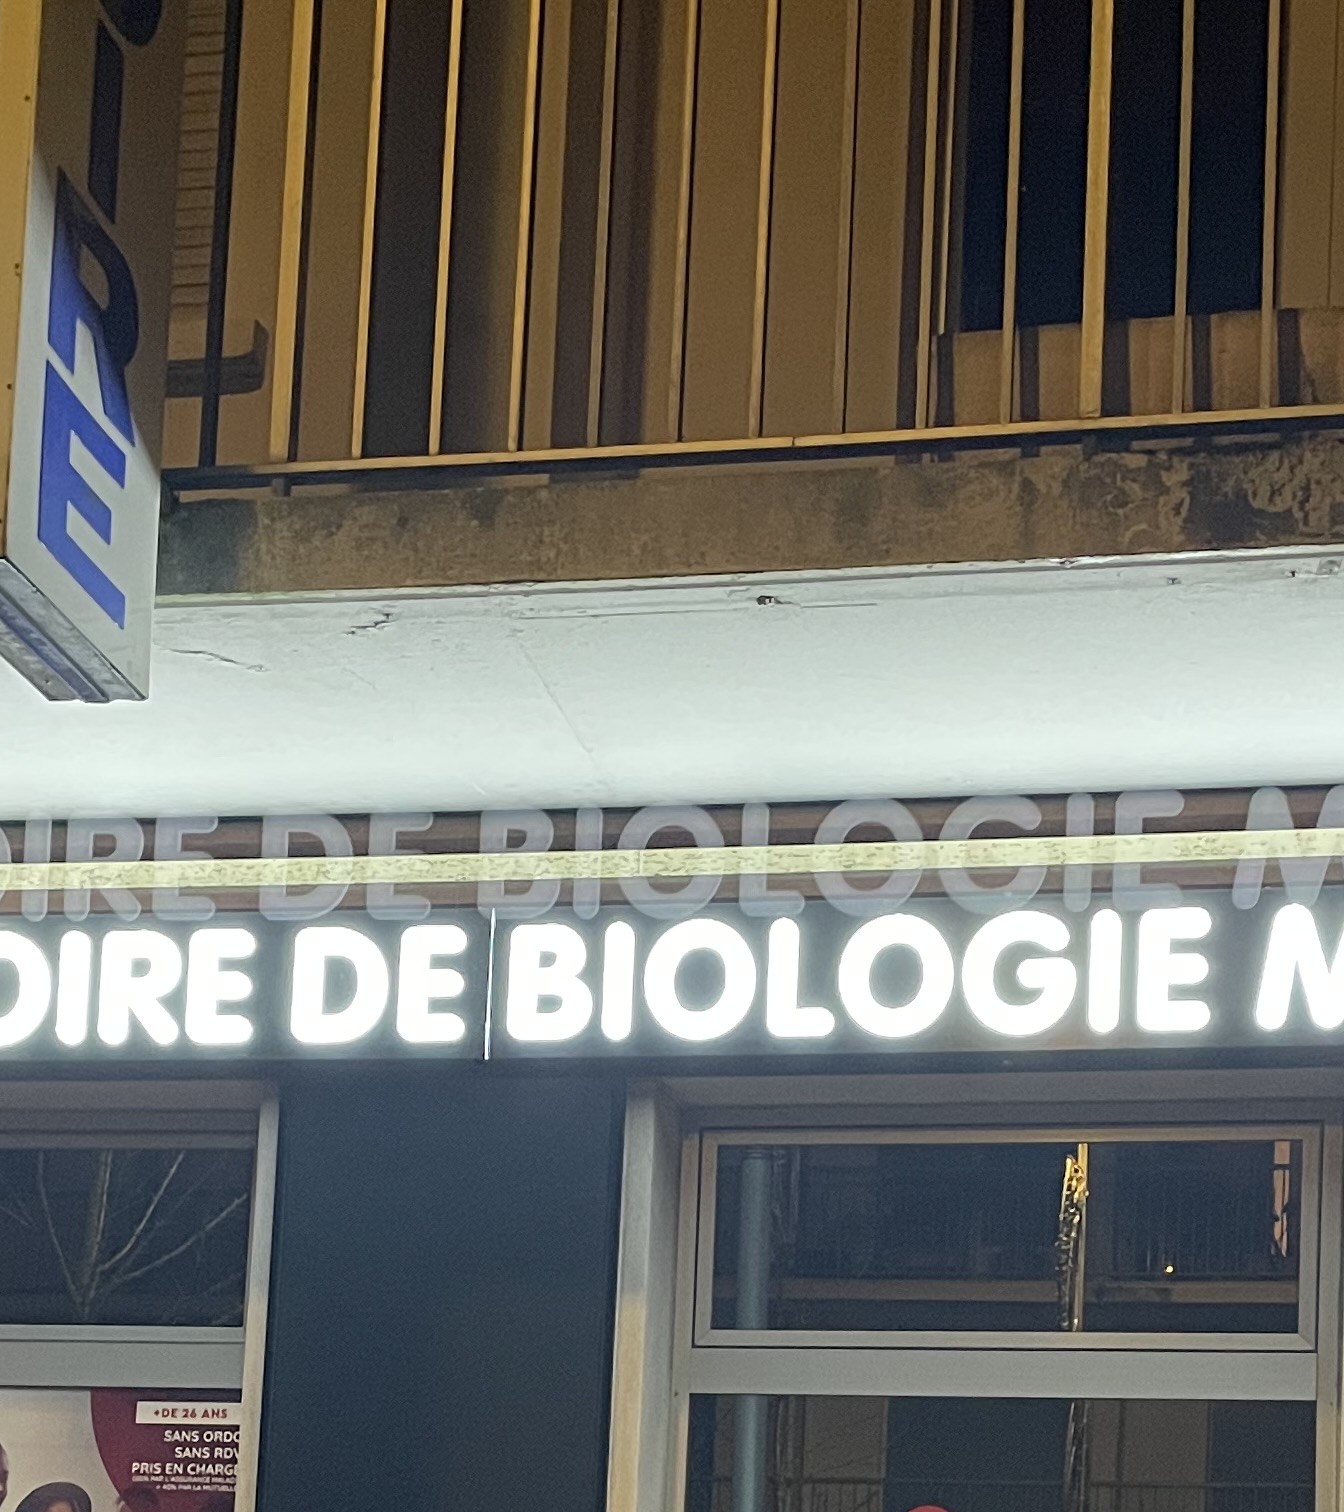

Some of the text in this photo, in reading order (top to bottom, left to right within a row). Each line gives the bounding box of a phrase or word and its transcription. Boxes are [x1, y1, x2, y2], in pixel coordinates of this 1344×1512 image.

[37, 0, 164, 630] IRE
[259, 810, 435, 921] DE
[289, 924, 469, 1044] DE
[506, 905, 1213, 1042] BIOLOGIE
[182, 1408, 197, 1418] 26
[201, 1408, 228, 1419] ANS
[163, 1430, 199, 1442] SANS
[174, 1446, 210, 1459] SANS
[131, 1462, 162, 1475] PRIS
[165, 1463, 183, 1475] EN
